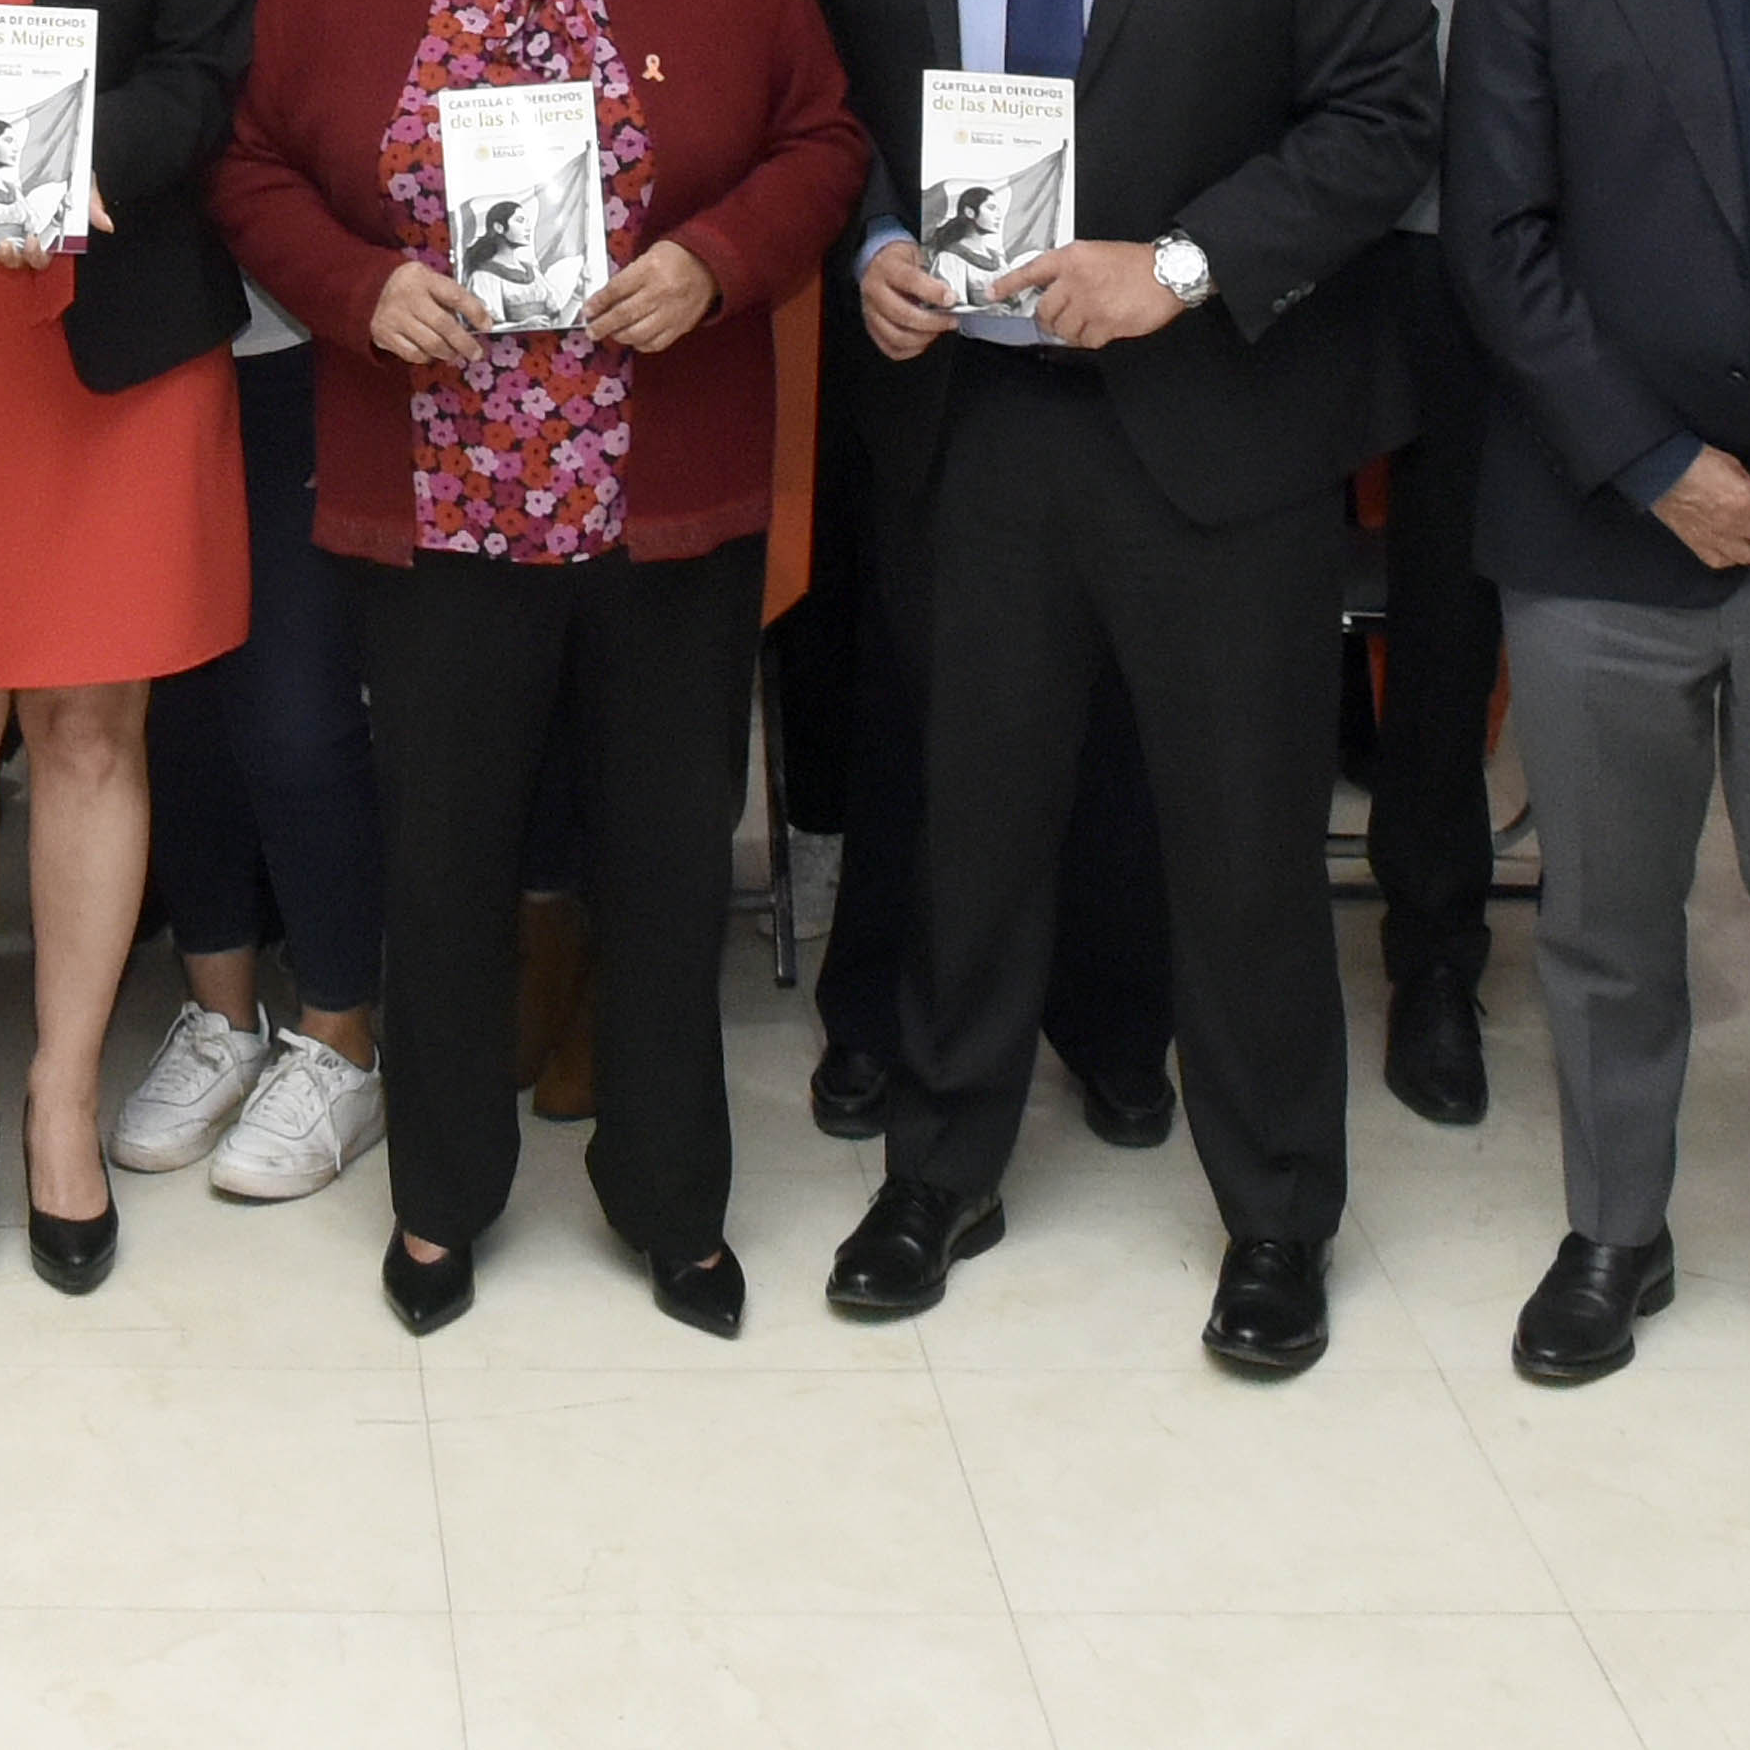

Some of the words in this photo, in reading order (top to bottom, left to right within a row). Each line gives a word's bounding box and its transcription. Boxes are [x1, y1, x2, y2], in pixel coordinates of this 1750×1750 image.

[9, 16, 23, 27] DE
[26, 17, 85, 29] DERECHOS
[11, 29, 84, 49] Mujeres
[932, 81, 985, 95] CARTILLA
[989, 85, 1001, 96] DE
[1005, 86, 1063, 100] DERECHOS
[448, 97, 502, 112] CARTILLA
[933, 94, 955, 111] de
[961, 95, 984, 113] las
[991, 98, 1063, 119] Mujeres
[450, 113, 472, 130] de
[478, 111, 503, 128] las
[509, 108, 584, 127] Mjeres
